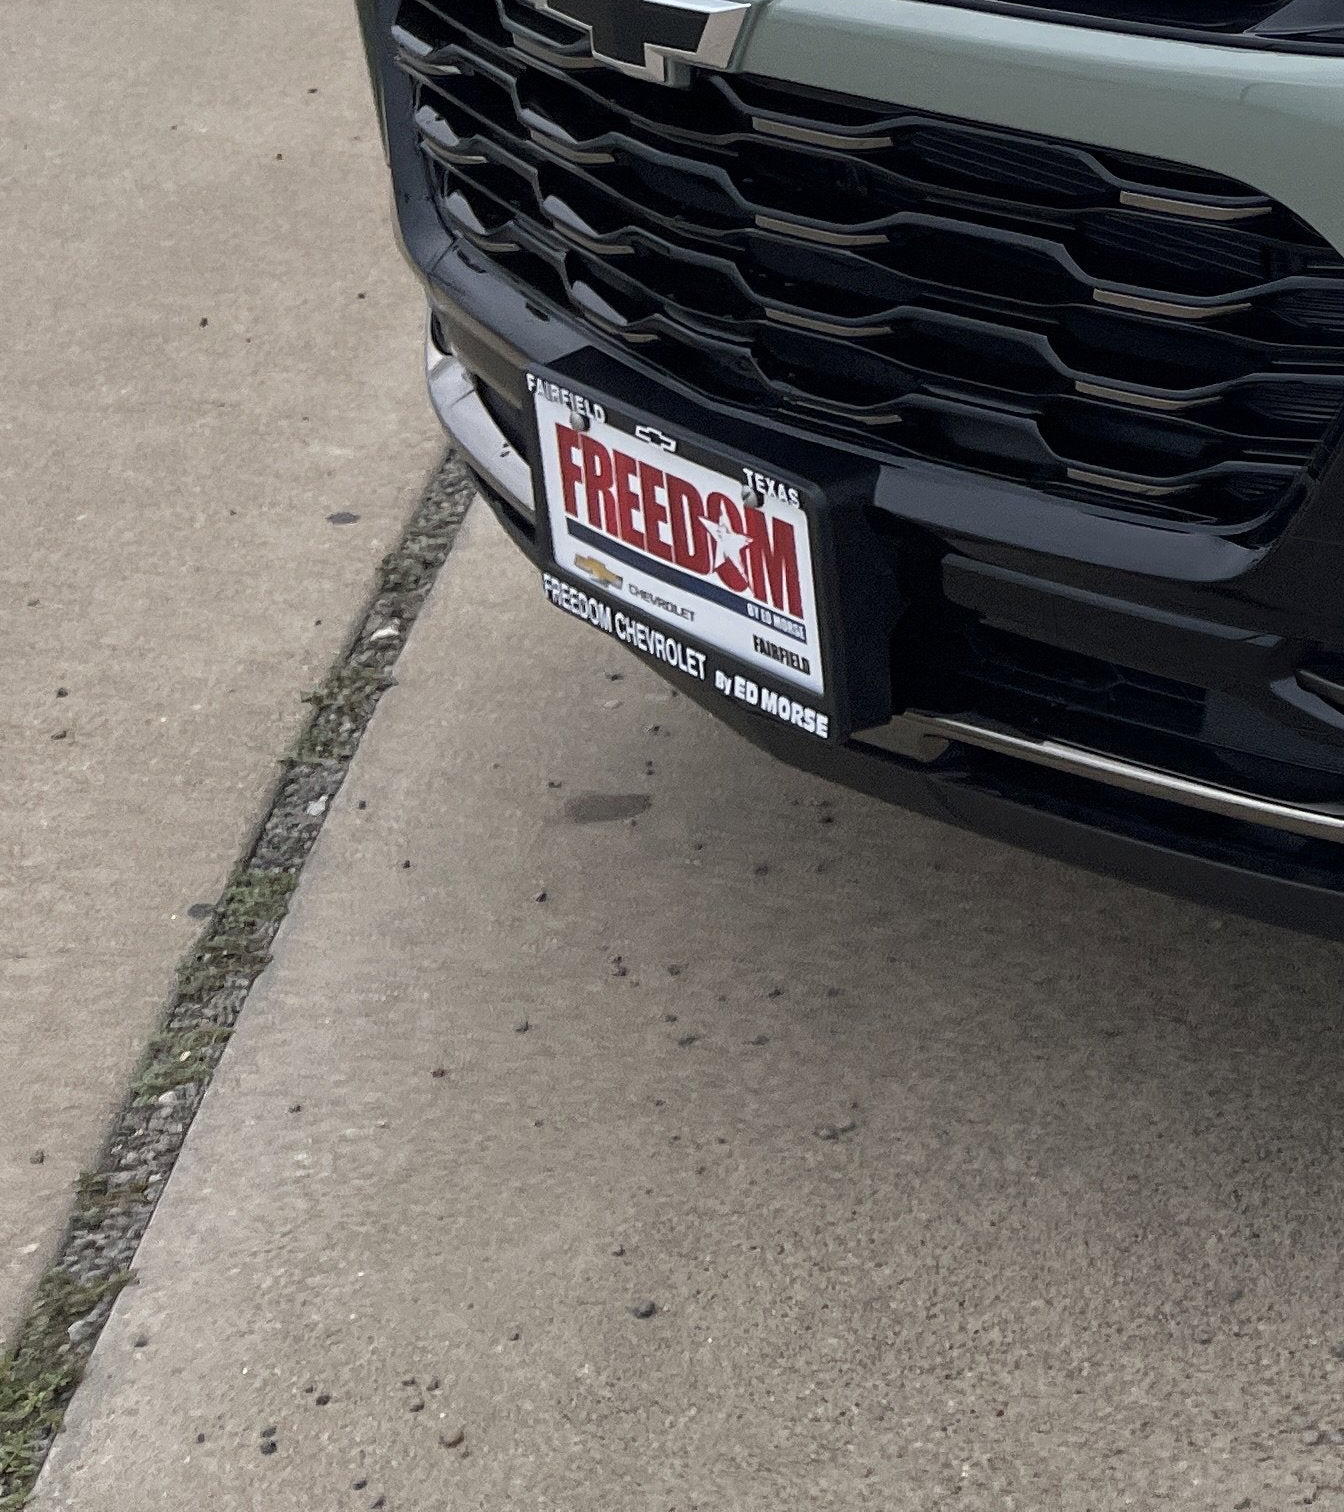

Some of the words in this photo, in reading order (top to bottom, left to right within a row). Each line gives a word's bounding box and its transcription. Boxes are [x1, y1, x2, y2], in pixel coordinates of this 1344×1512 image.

[526, 373, 606, 424] FAIRFIELD
[742, 467, 800, 509] TEXAS
[555, 422, 804, 619] FREEDOM
[628, 583, 695, 622] CHEVROLET
[543, 572, 613, 633] FREEDOM
[614, 611, 707, 681] CHEVROLET
[734, 675, 759, 706] ED
[760, 687, 829, 740] MORSE
